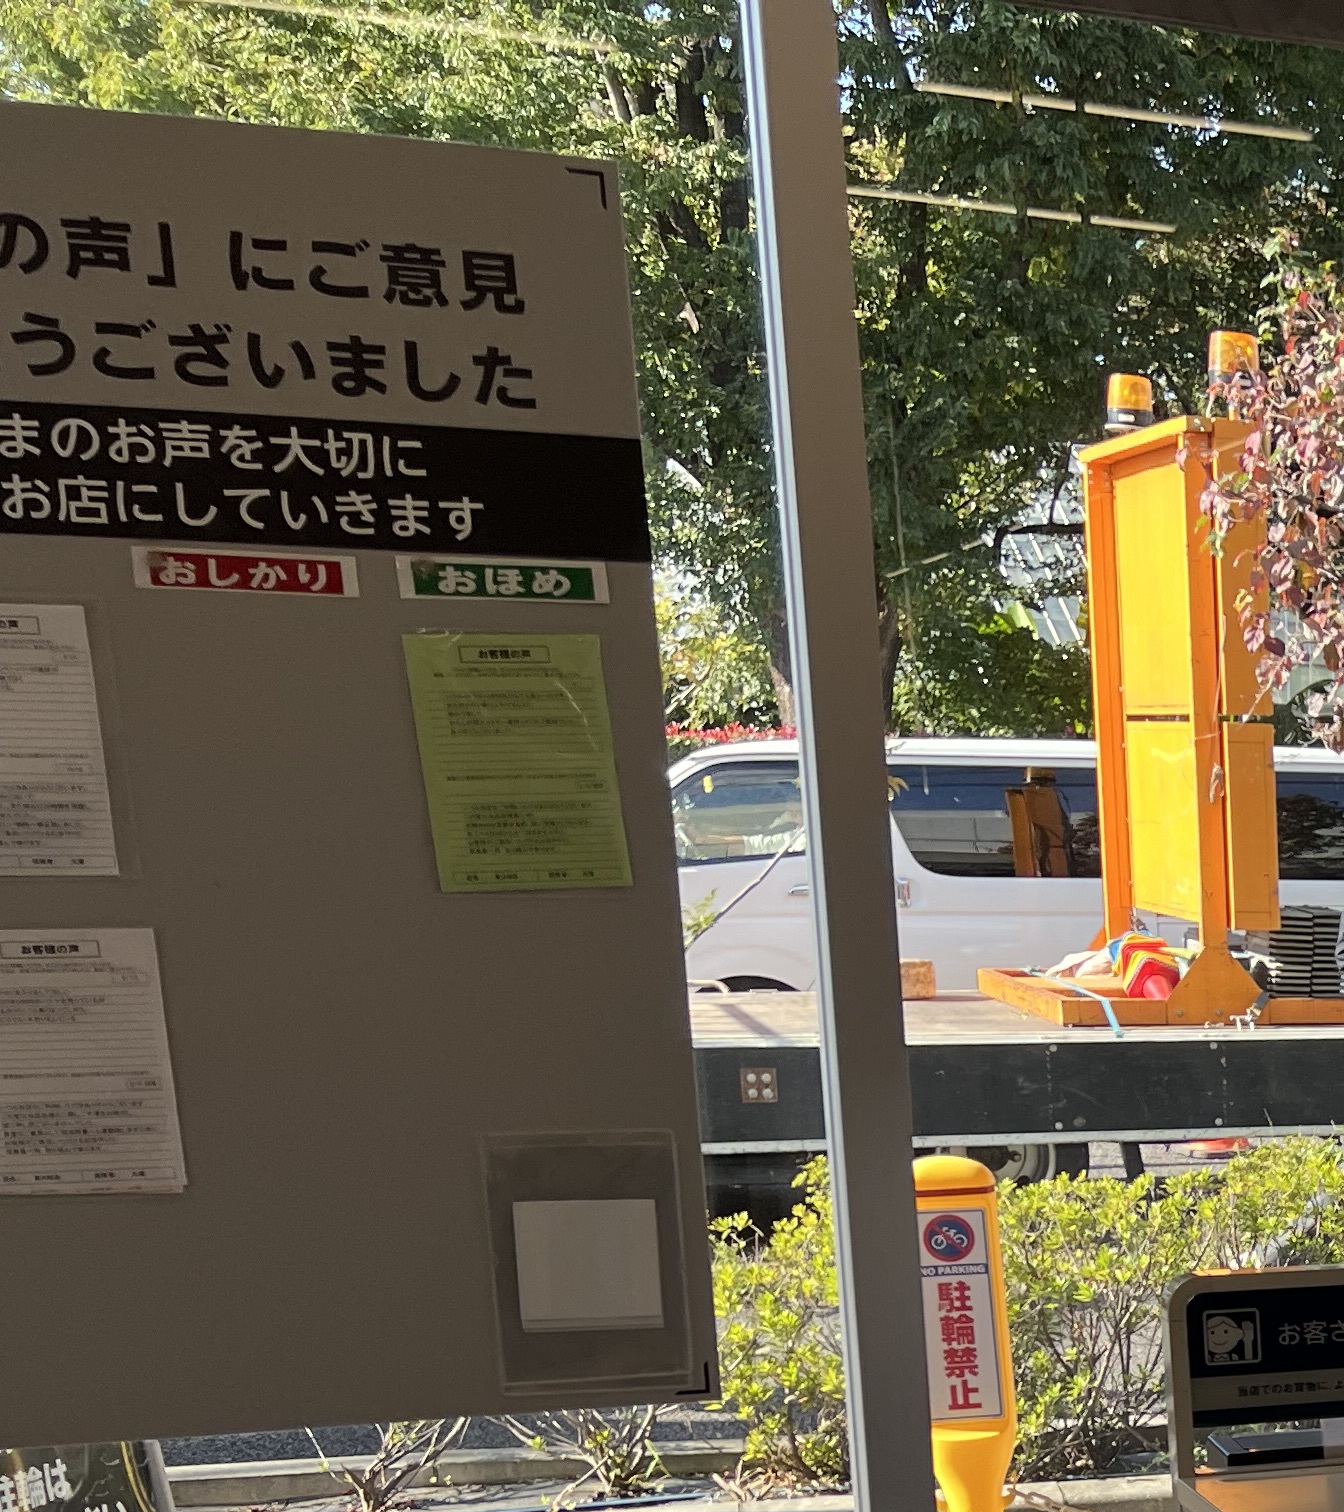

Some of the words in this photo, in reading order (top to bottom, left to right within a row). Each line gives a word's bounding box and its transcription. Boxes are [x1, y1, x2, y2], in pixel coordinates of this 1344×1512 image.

[10, 311, 537, 411] うございました
[0, 412, 429, 480] まのお声を大切に
[1, 473, 485, 541] お店にしていきます
[159, 556, 329, 590] おしかり
[437, 564, 573, 599] おほめ
[937, 1263, 987, 1276] PARKING
[936, 1279, 983, 1411] 駐輪禁止
